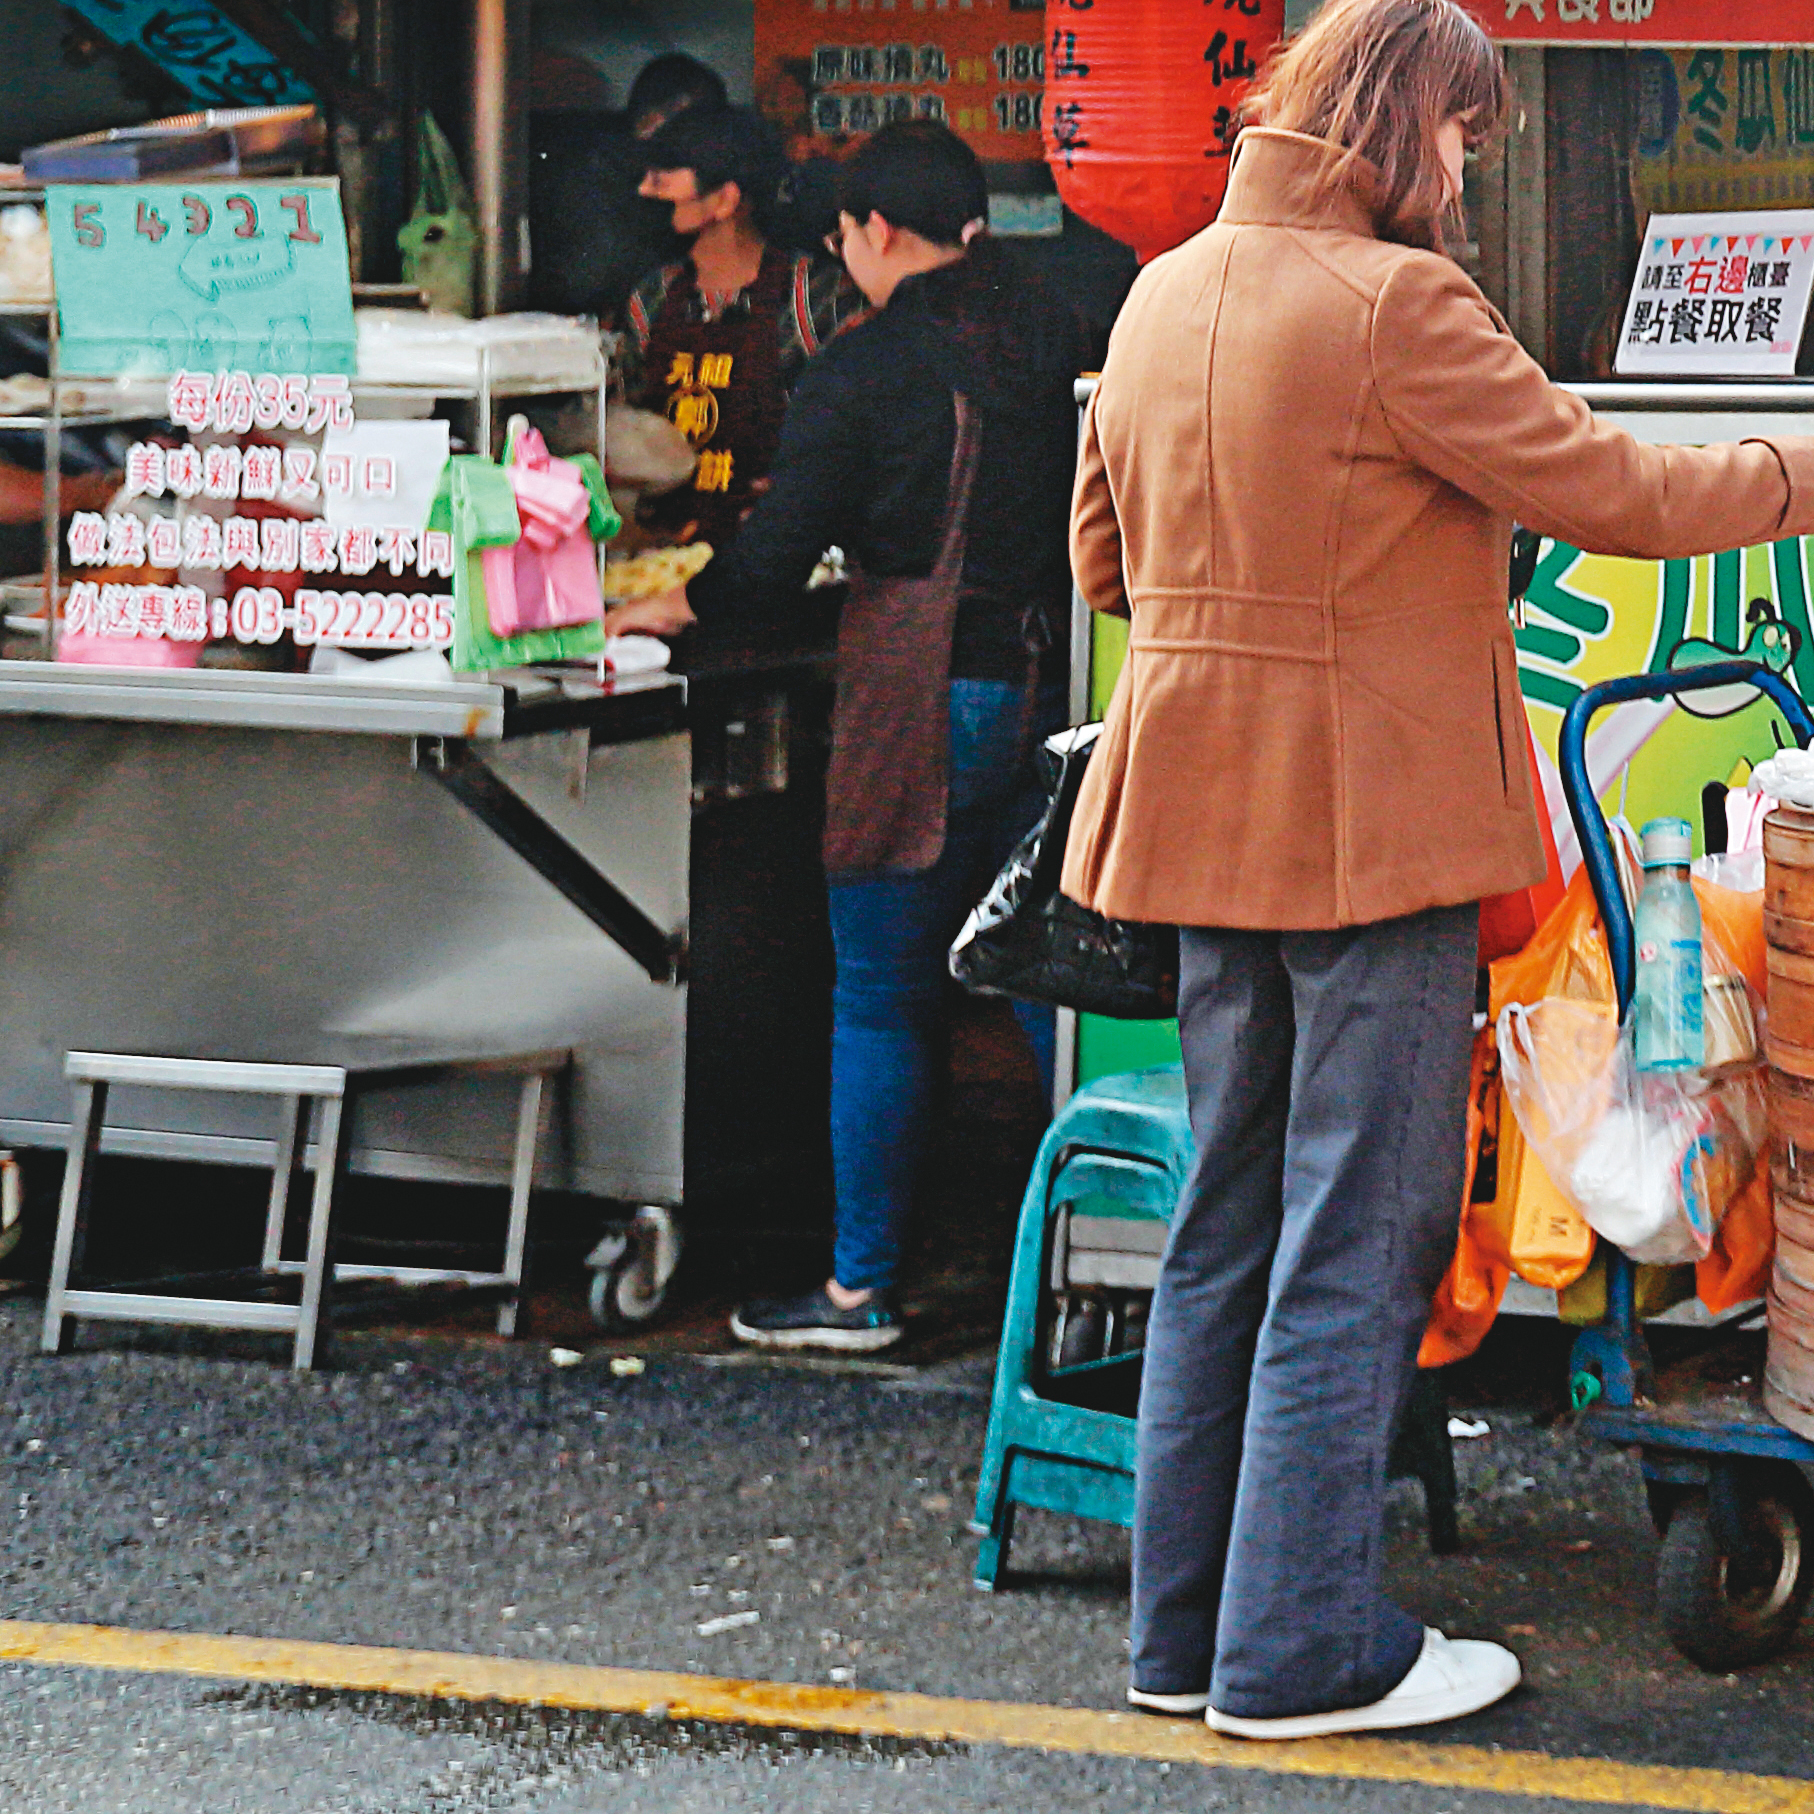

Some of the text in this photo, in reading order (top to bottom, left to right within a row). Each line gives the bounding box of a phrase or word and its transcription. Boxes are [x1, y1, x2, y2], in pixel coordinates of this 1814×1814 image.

[1628, 297, 1782, 346] 點餐取餐
[168, 372, 355, 432] 每份35元
[128, 441, 396, 501] 美味新鮮又可口
[68, 511, 455, 578] 做法包法與別家都不同
